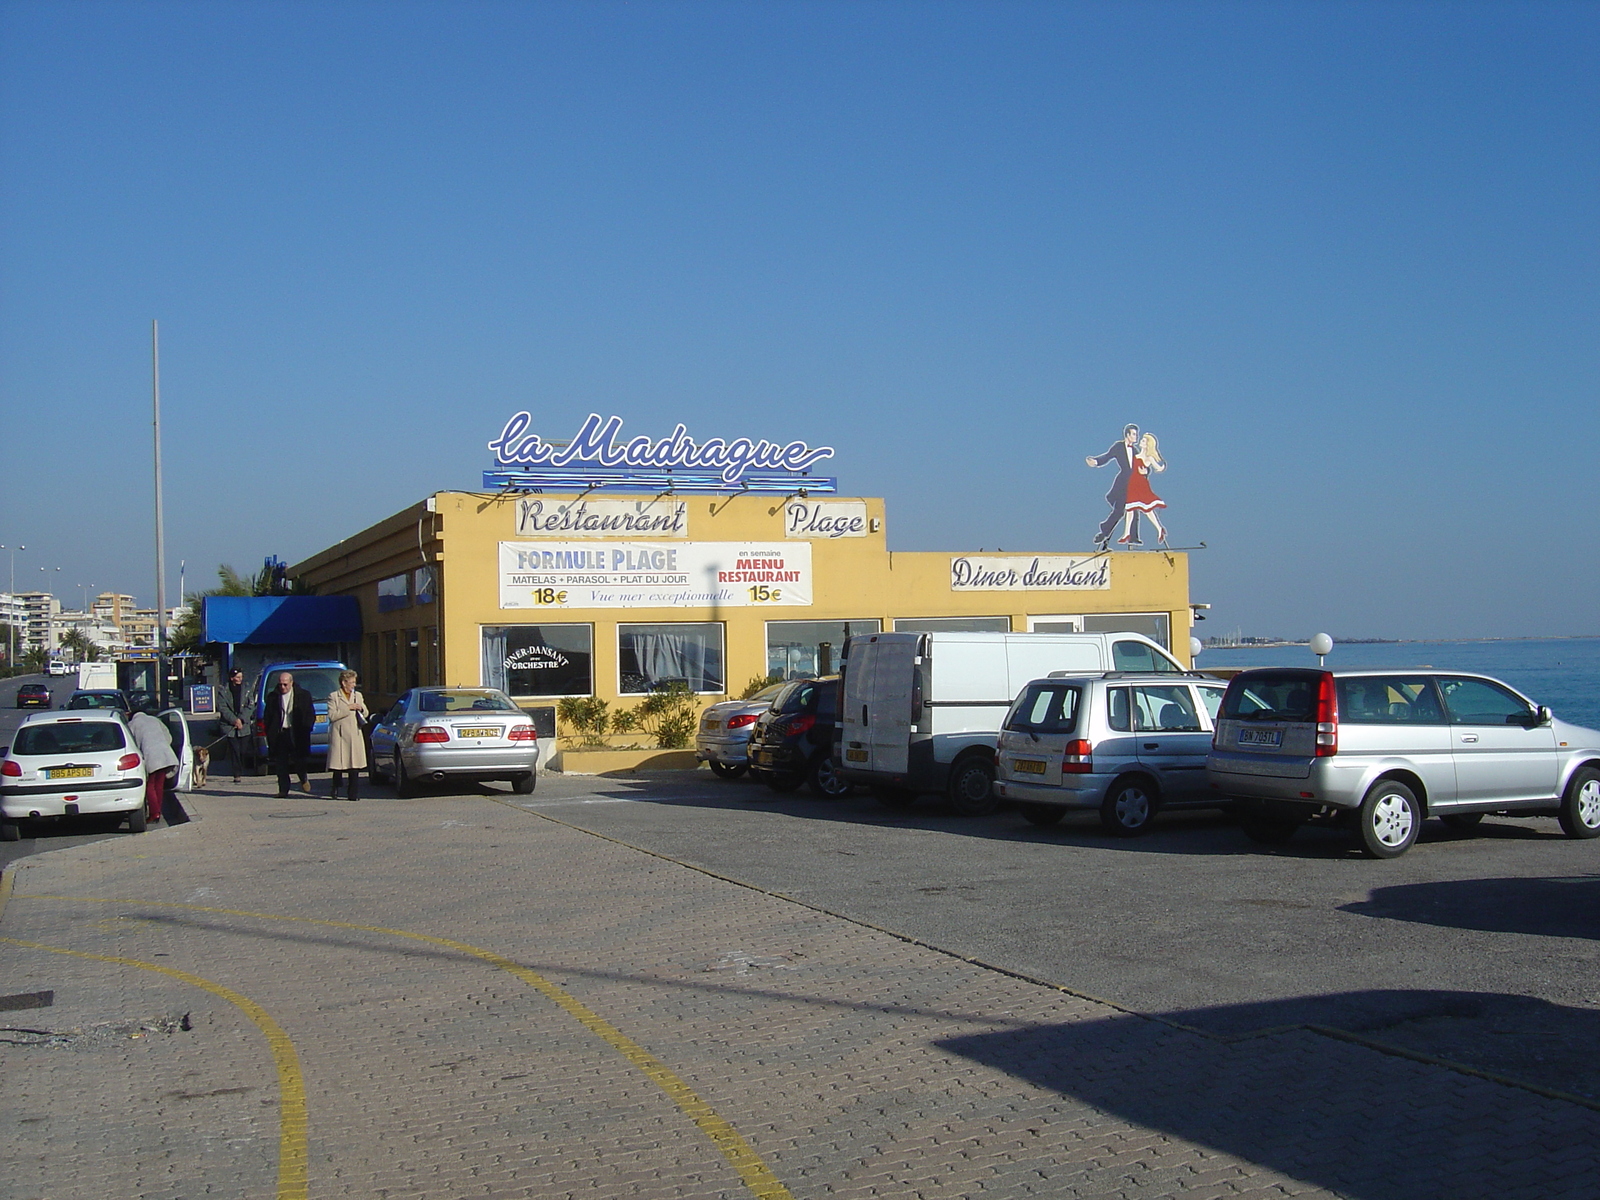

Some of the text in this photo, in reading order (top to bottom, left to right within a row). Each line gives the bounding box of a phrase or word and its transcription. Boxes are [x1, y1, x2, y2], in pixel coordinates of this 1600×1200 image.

[488, 411, 835, 483] la Madrague
[520, 500, 687, 532] Restaurant
[787, 502, 864, 537] Plage
[518, 549, 677, 571] FORMULE PLAGE
[735, 559, 785, 570] MENU
[512, 575, 557, 584] MATELAS
[566, 575, 611, 584] PARASOL
[620, 575, 645, 584] PLAT
[646, 575, 659, 583] DU
[661, 575, 688, 583] JOUR
[718, 571, 801, 583] RESTAURANT
[953, 557, 1109, 587] Diner dansant
[532, 587, 569, 605] 18€
[590, 589, 734, 604] Vue mer exceptionnelle
[748, 585, 782, 602] 15€
[511, 661, 559, 670] ORCHESTRE
